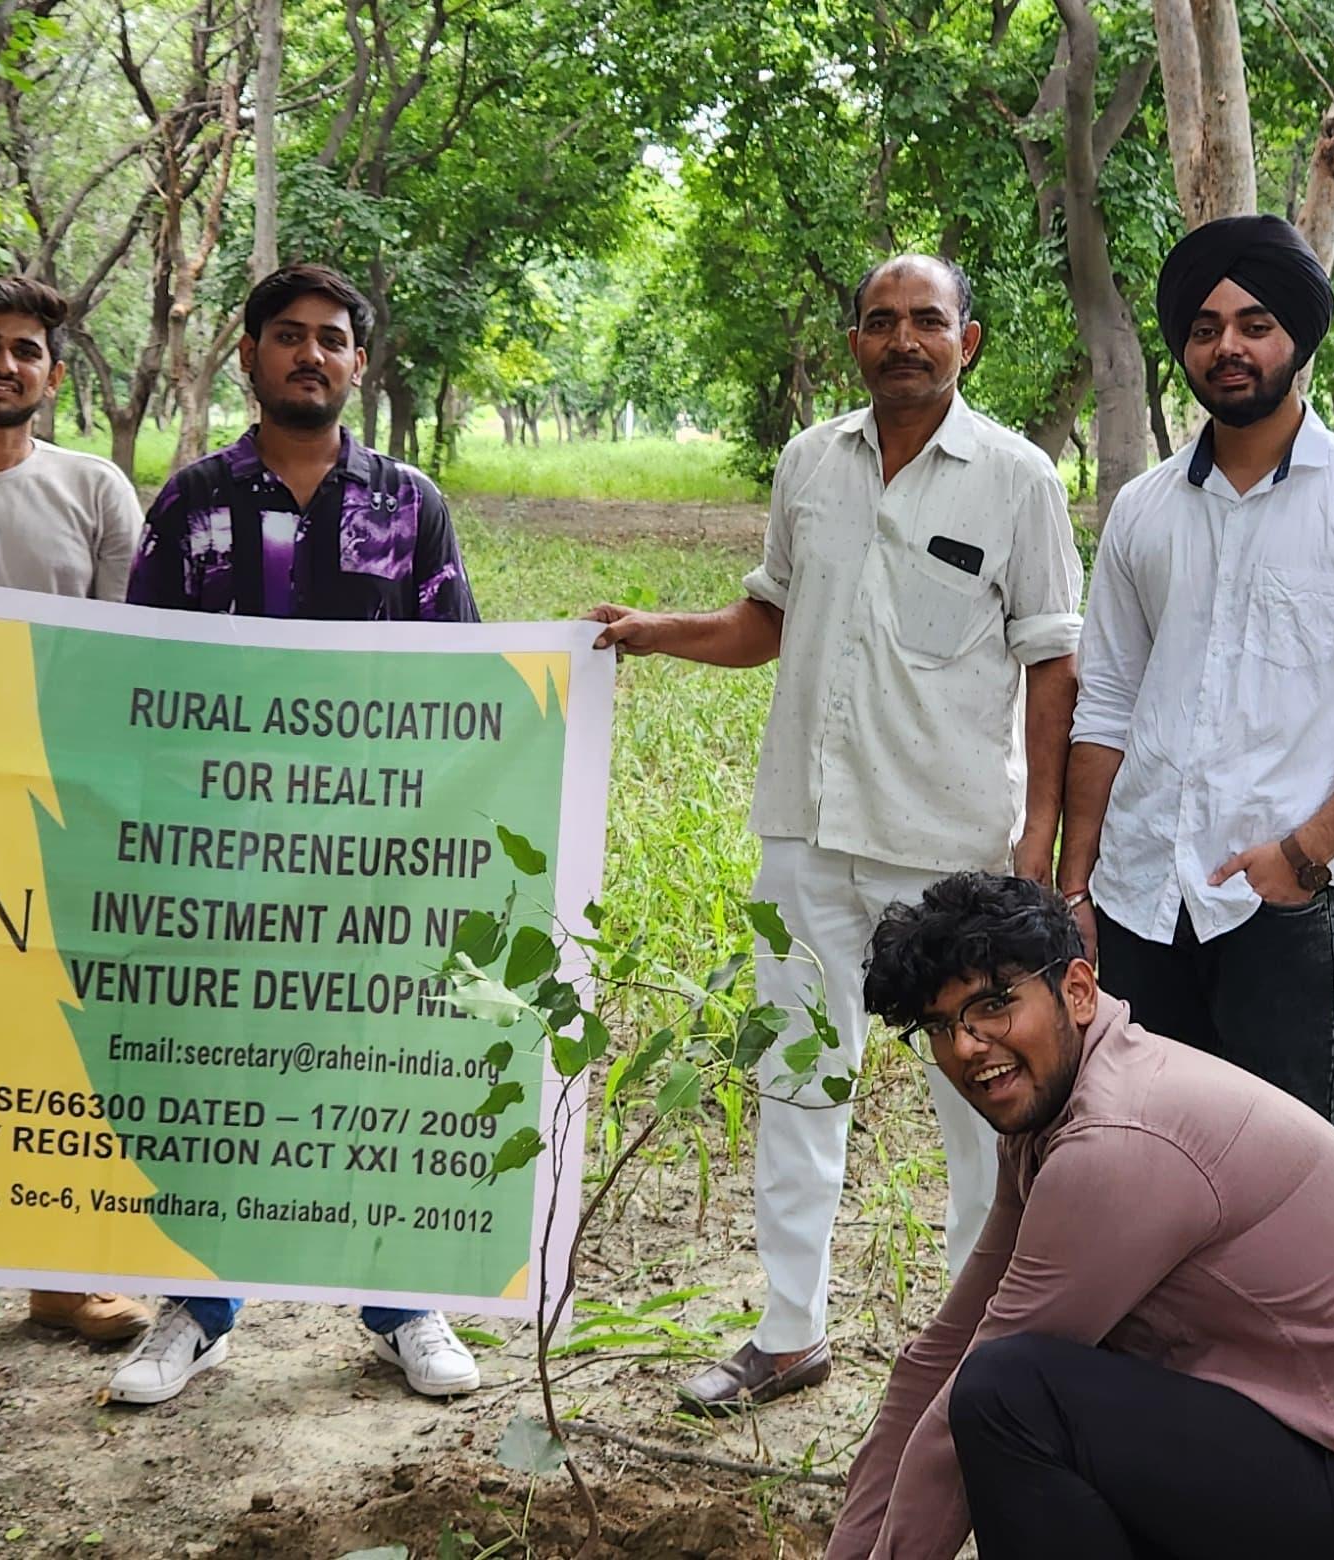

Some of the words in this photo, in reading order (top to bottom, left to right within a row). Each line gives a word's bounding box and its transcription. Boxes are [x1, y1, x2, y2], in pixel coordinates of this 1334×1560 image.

[129, 687, 251, 733] RURAL
[262, 697, 503, 742] ASSOCIATION
[201, 760, 273, 803] FOR
[286, 765, 424, 808] HEALTH
[117, 820, 493, 879] ENTREPRENEURSHIP
[90, 891, 328, 945] INVESTMENT
[336, 905, 411, 947] AND
[69, 959, 243, 1010] VENTURE
[158, 1096, 265, 1129] DATED
[310, 1103, 411, 1135] 17/07/
[420, 1110, 498, 1140] 2009
[12, 1127, 260, 1166] REGISTRATION
[270, 1141, 336, 1171] ACT
[345, 1144, 398, 1173] XXI
[10, 1184, 80, 1214] Sec-6,
[91, 1189, 227, 1222] Vasundhara,
[236, 1196, 357, 1230] Ghaziabad,
[367, 1204, 406, 1228] UP-
[413, 1207, 493, 1234] 201012
